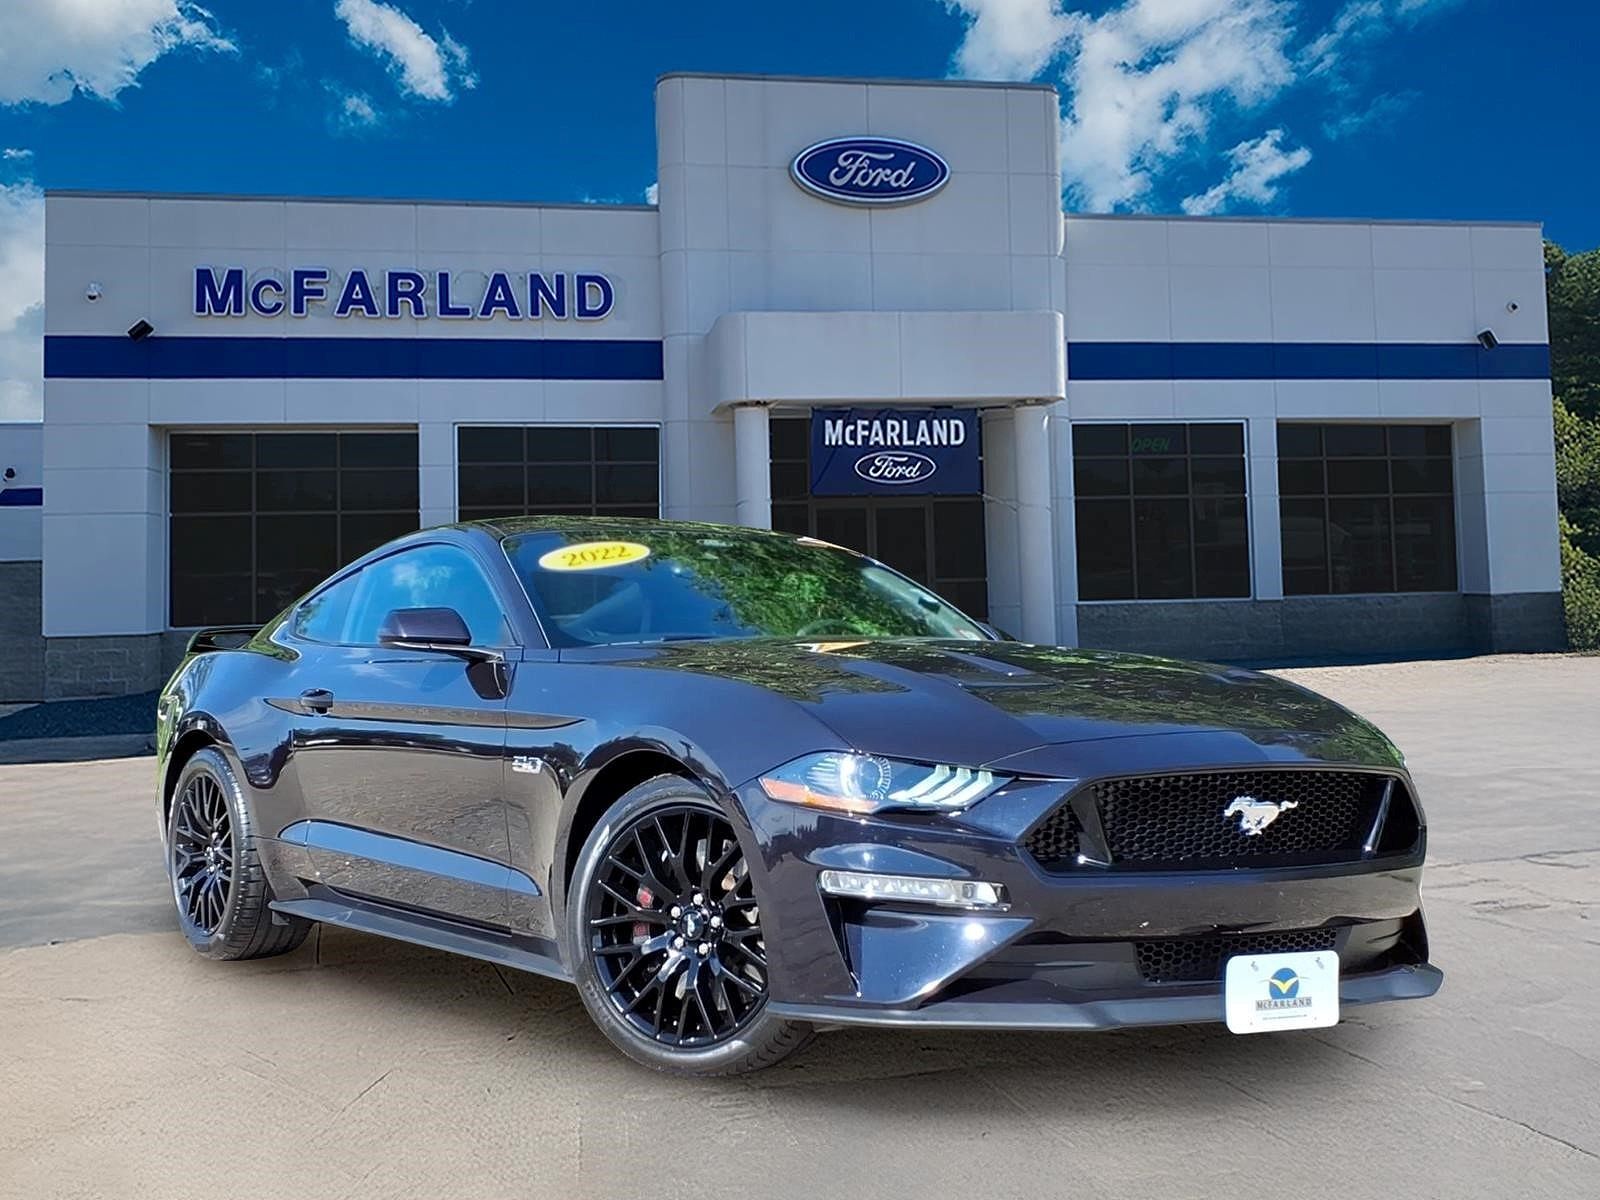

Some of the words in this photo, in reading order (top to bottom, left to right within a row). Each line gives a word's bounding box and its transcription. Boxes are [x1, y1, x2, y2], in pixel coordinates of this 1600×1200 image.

[829, 150, 916, 188] Ford
[193, 267, 615, 319] McFARLAND
[824, 419, 966, 446] McFARLAND
[1131, 437, 1170, 454] OPEN
[869, 455, 922, 478] Ford
[562, 545, 632, 567] 2022
